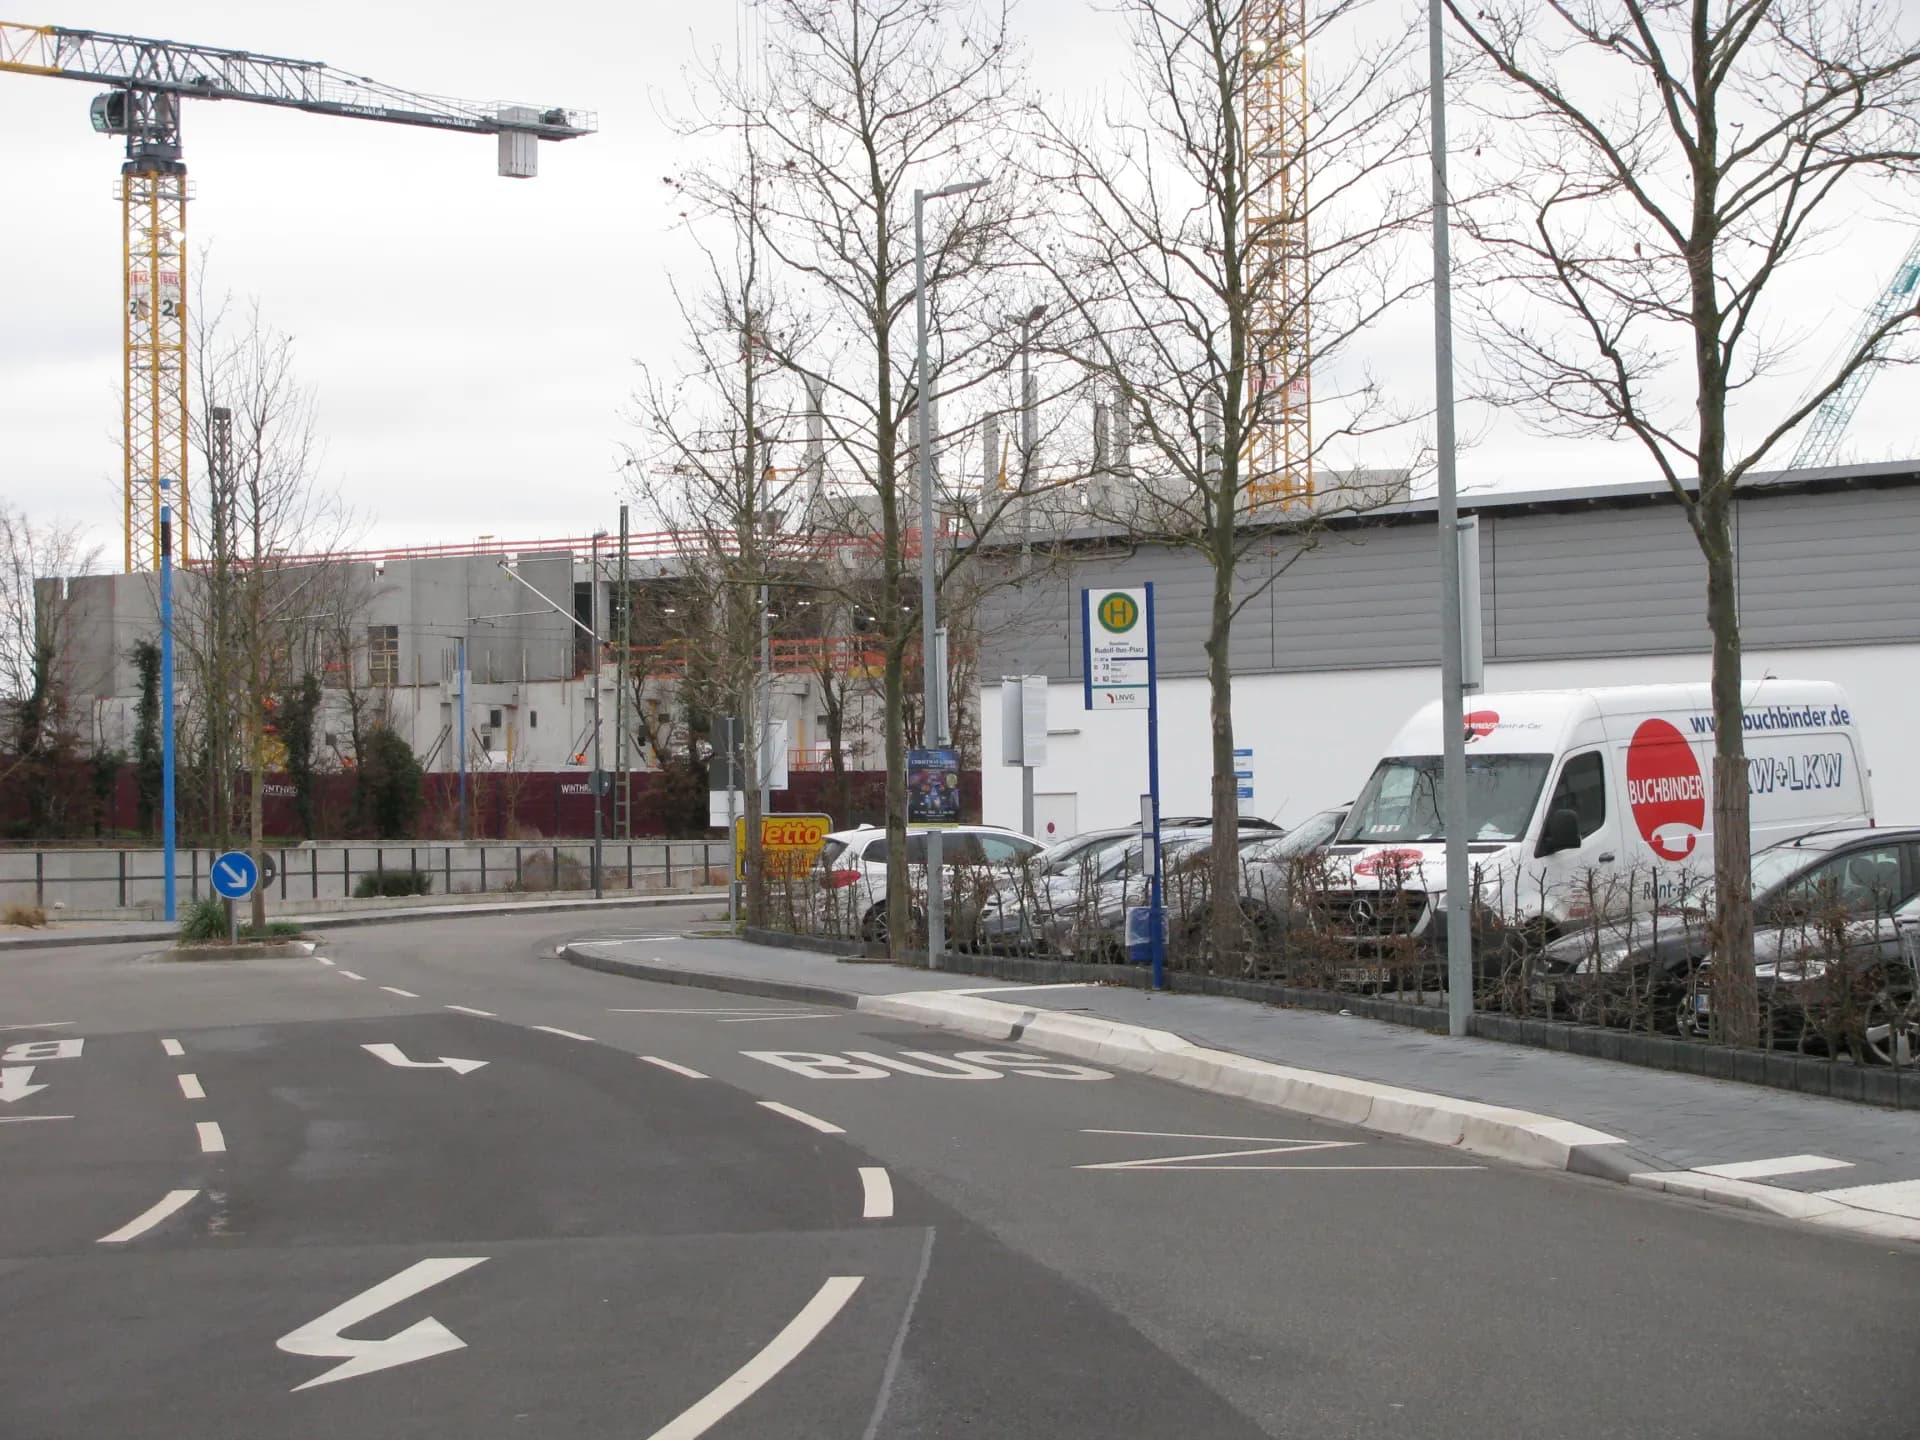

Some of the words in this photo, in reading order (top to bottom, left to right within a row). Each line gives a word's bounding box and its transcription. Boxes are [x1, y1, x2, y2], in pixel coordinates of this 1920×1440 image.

[1110, 601, 1127, 625] H
[1690, 704, 1850, 733] wwbuchbinder.de
[1628, 775, 1705, 805] BUCHBINDER
[738, 1051, 1115, 1080] BUS
